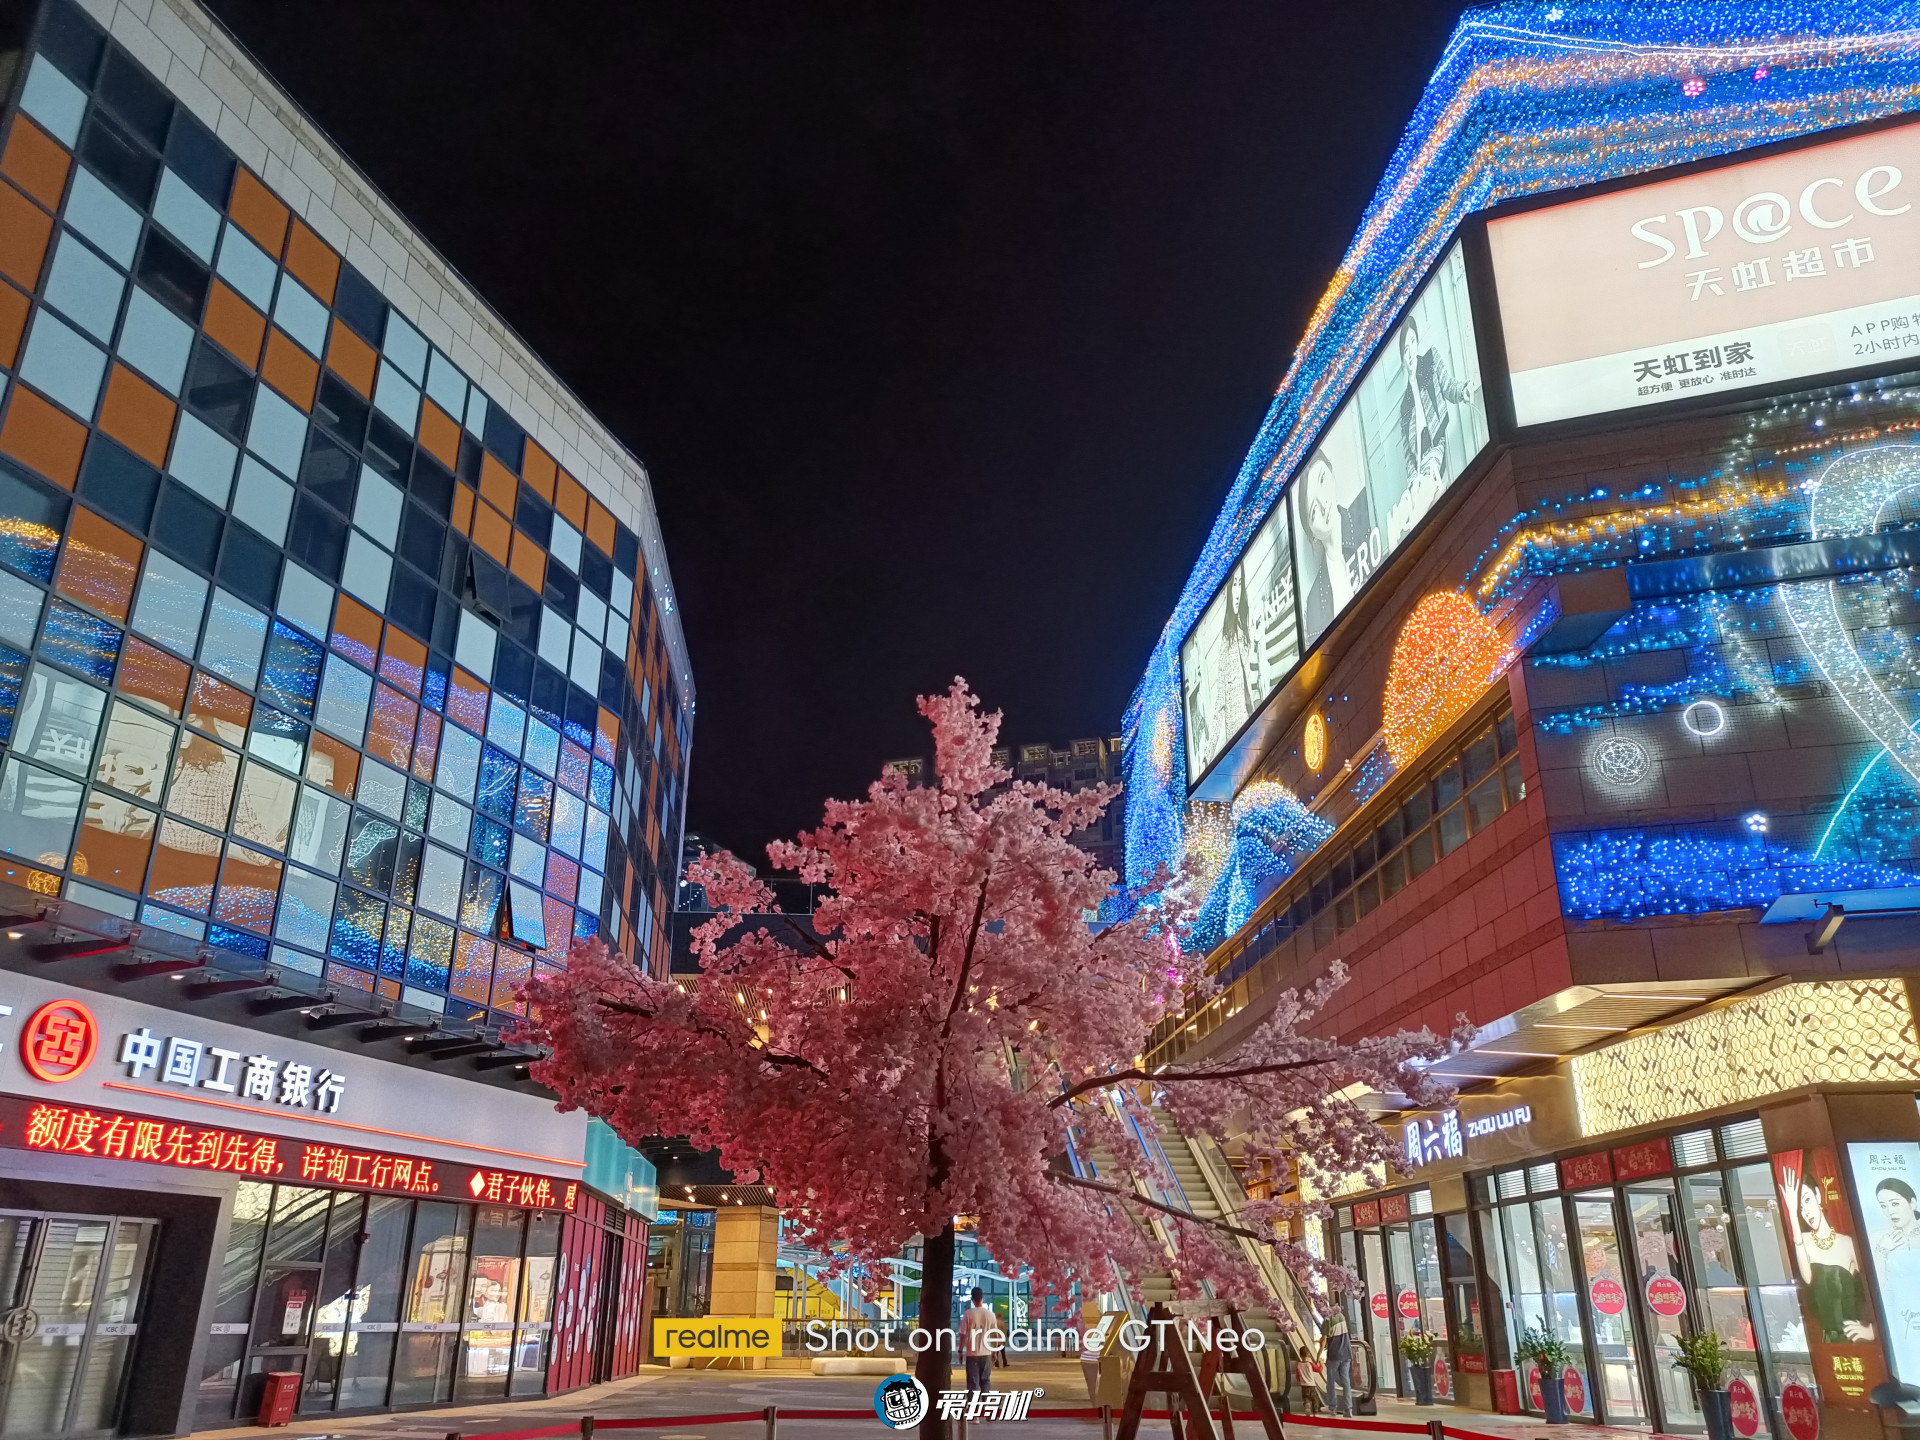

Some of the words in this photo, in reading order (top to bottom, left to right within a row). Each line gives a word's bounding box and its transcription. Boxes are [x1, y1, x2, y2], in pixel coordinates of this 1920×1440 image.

[1684, 236, 1876, 301] 天虹超市
[1633, 341, 1754, 382] 天虹到家
[1637, 381, 1673, 396] 超方便
[1679, 375, 1714, 389] 更放心
[1719, 367, 1757, 381] 准时达
[120, 1027, 346, 1114] 中国工商银行
[1406, 1108, 1463, 1167] 周六福
[1467, 1116, 1496, 1138] ZHOU
[1495, 1110, 1515, 1130] LIU
[1514, 1105, 1532, 1125] FU
[1869, 1154, 1906, 1165] 周六福
[1832, 1355, 1863, 1373] 周六福
